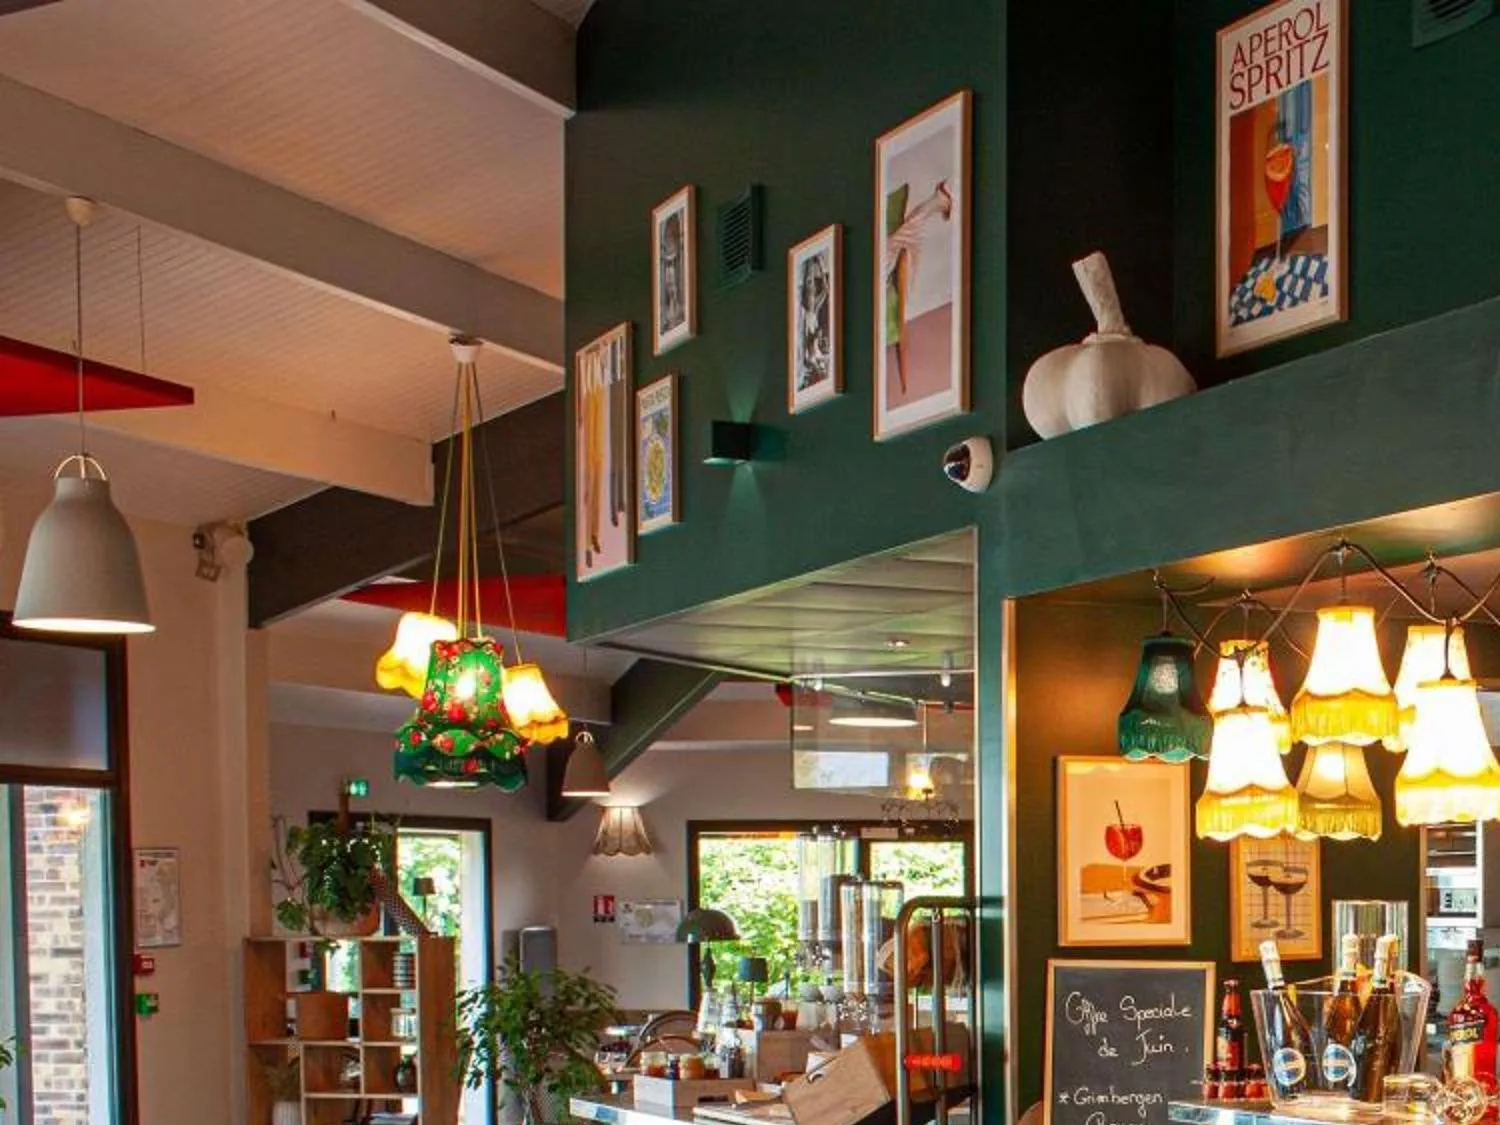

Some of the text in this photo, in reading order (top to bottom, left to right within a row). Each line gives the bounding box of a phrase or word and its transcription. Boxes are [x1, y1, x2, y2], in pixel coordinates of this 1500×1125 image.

[1229, 30, 1330, 110] SPRITZ
[1230, 2, 1329, 74] APEROL
[1097, 1037, 1119, 1057] de
